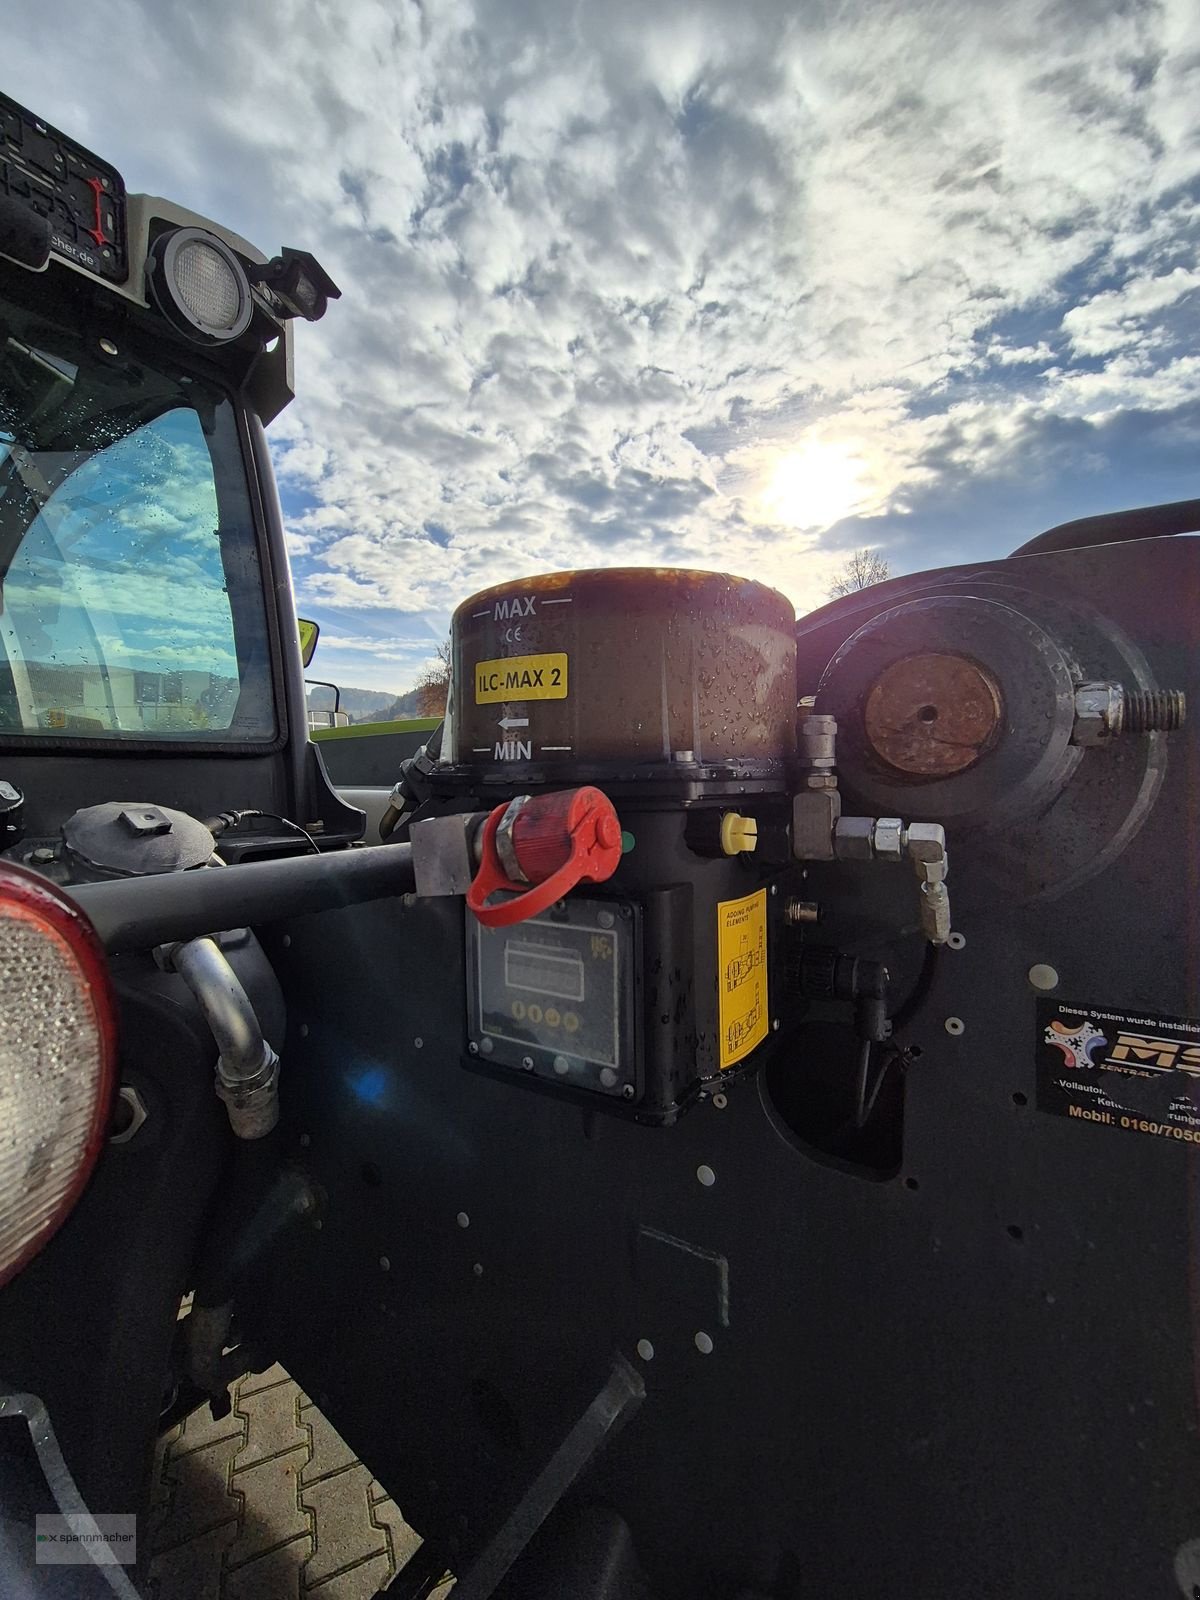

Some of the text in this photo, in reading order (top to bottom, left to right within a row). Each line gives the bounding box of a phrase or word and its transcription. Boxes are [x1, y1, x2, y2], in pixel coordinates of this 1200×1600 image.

[494, 595, 537, 621] MAX
[505, 626, 522, 643] CE
[479, 667, 562, 692] ILC-MAX 2
[494, 740, 532, 761] MIN
[726, 914, 749, 927] ELEMENTS
[1058, 1005, 1089, 1017] Dieses
[1090, 1010, 1125, 1023] System
[1126, 1016, 1157, 1027] wurde
[1068, 1105, 1116, 1125] Mobil:
